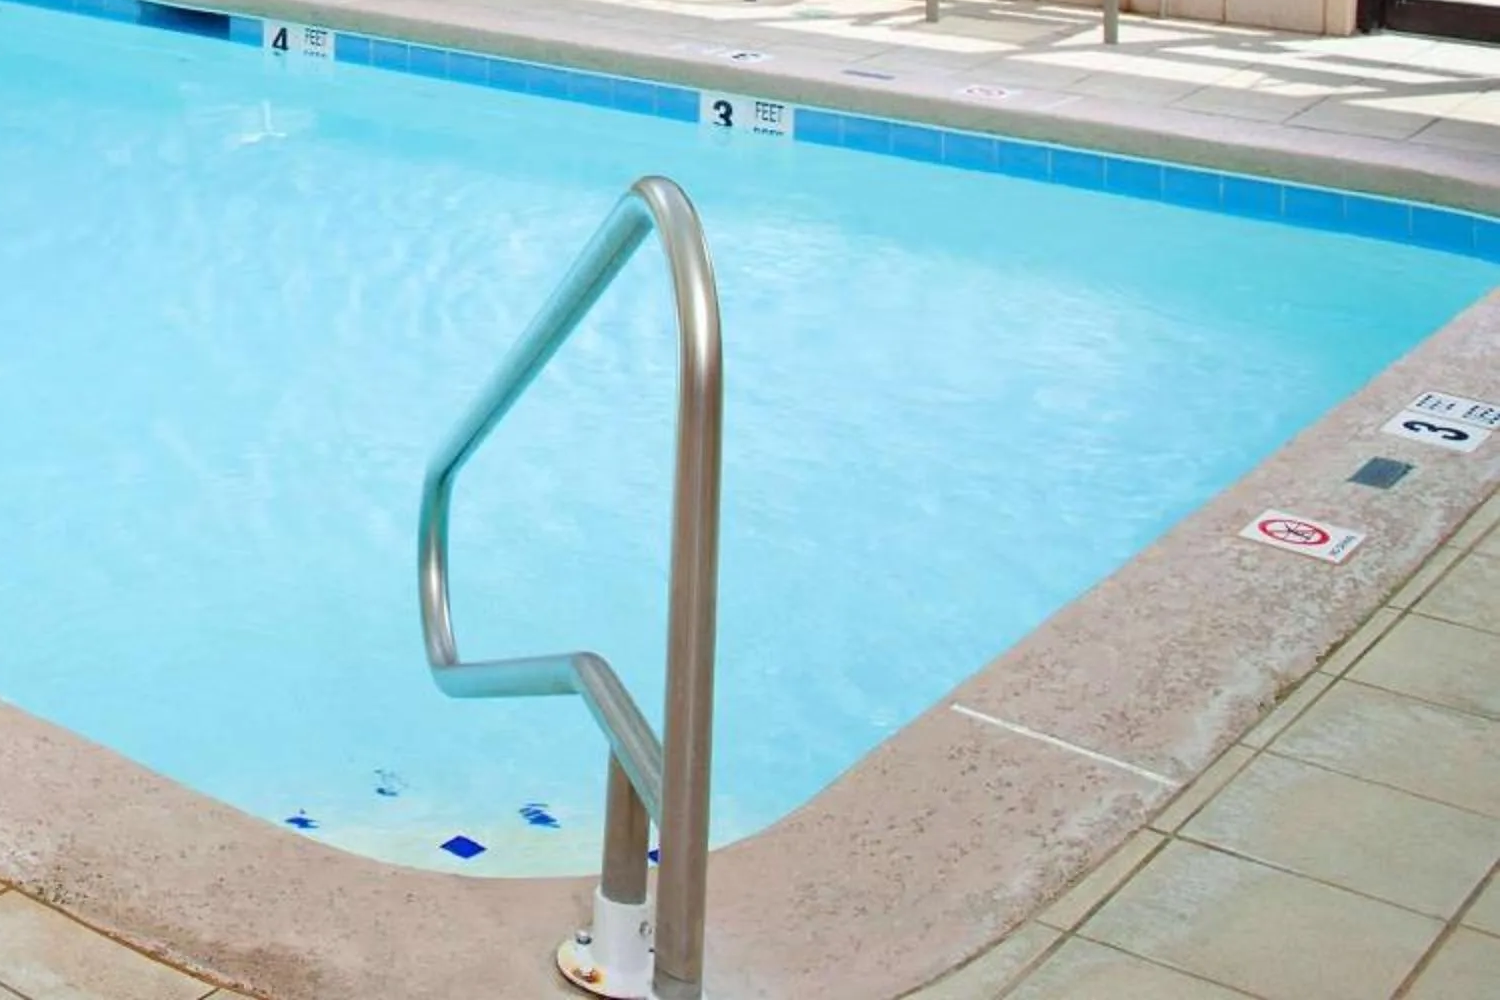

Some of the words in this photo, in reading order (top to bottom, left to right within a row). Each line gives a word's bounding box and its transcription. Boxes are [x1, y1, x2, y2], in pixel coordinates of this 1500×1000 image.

[272, 27, 289, 51] 4
[713, 100, 733, 127] 3
[755, 101, 785, 123] FEET
[1402, 421, 1470, 441] 3
